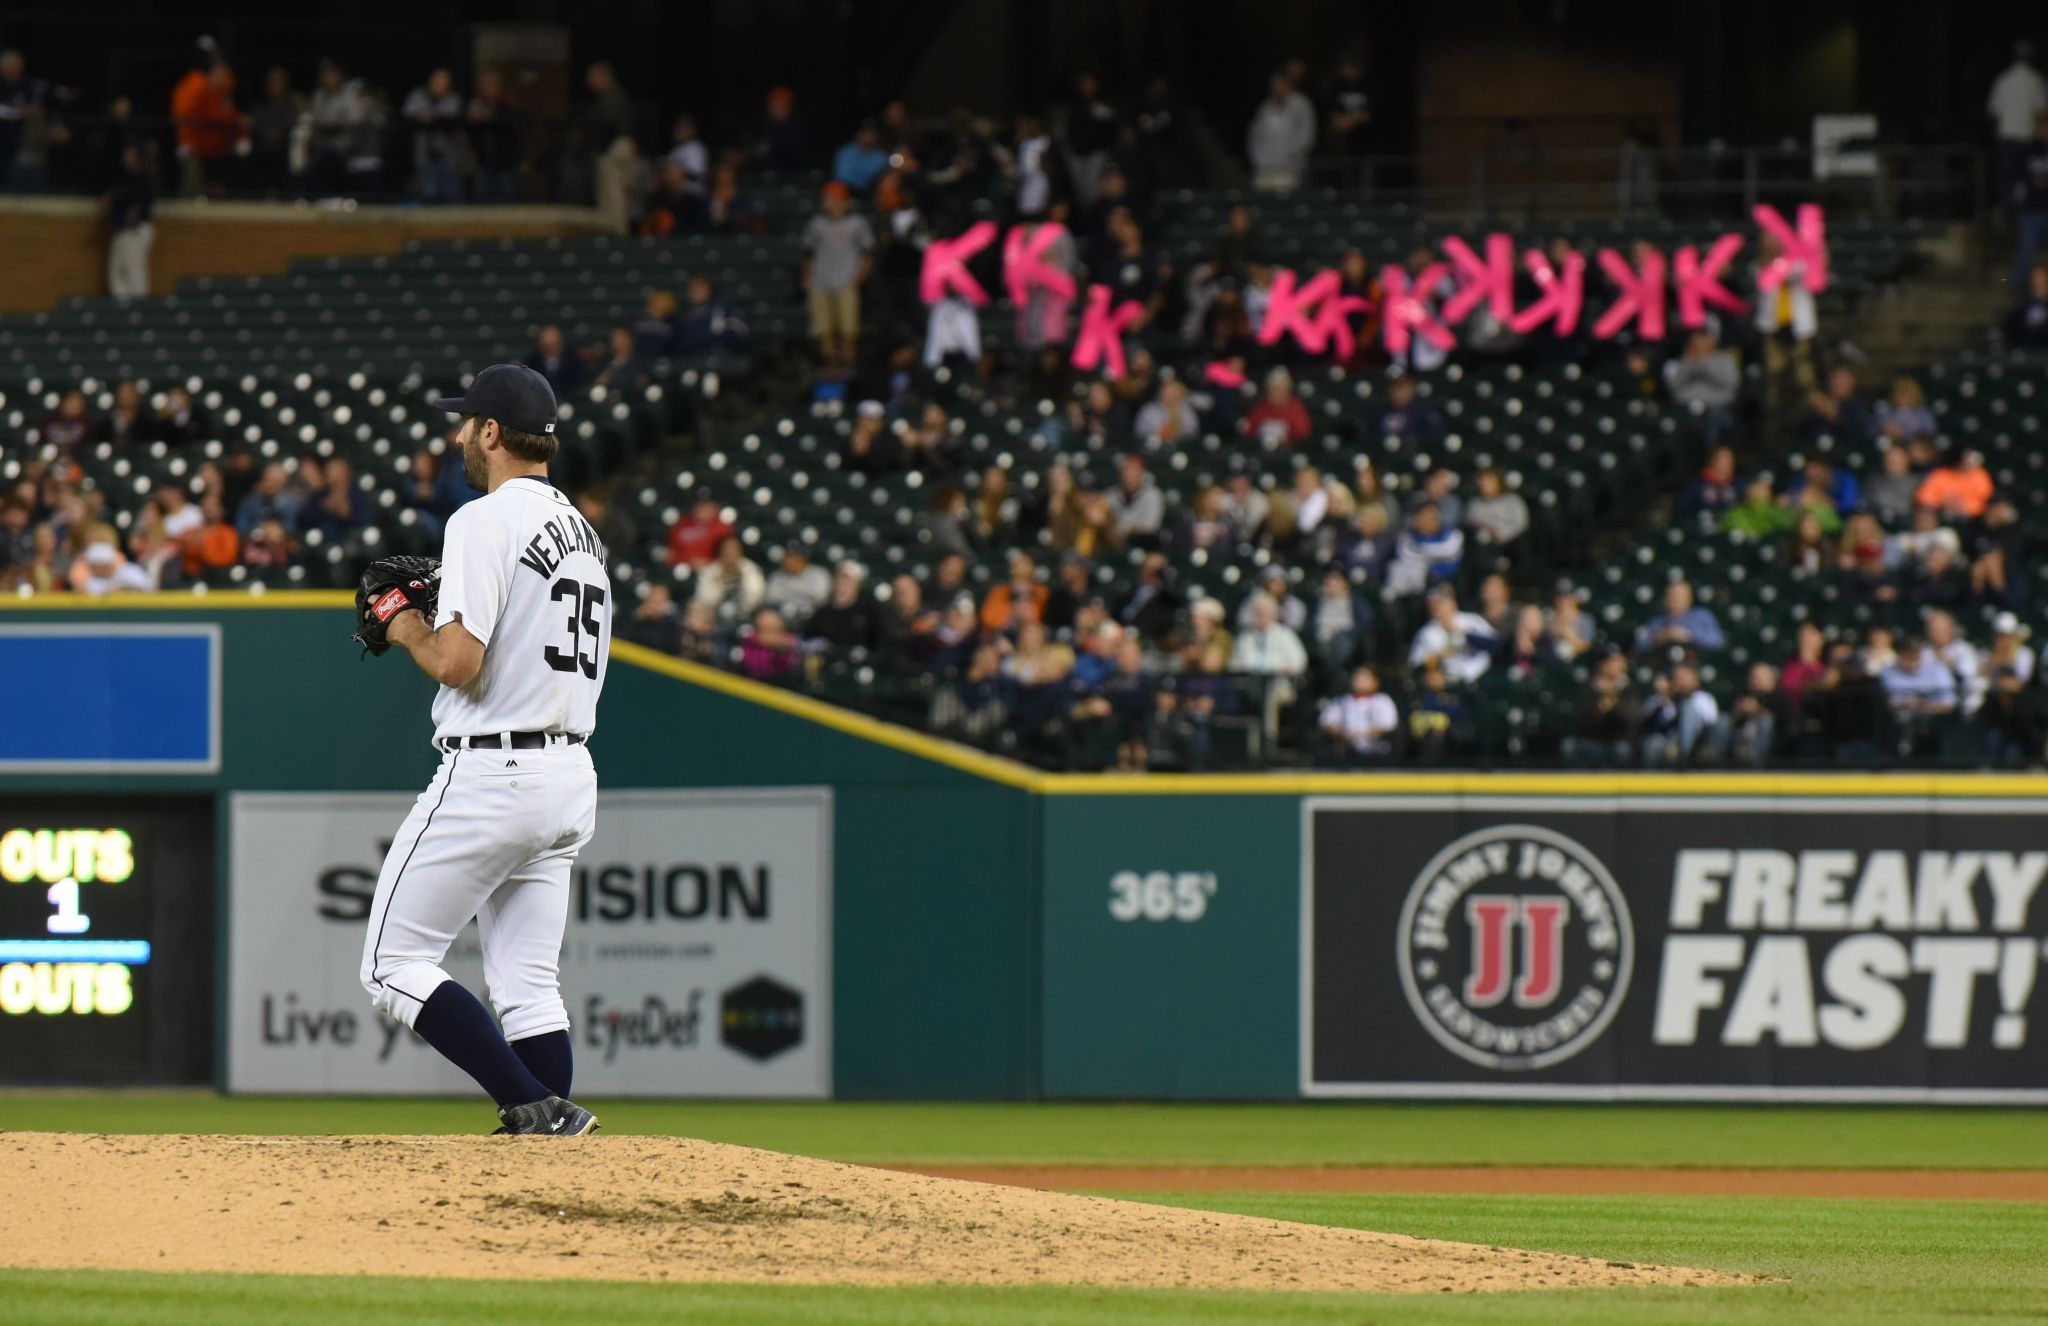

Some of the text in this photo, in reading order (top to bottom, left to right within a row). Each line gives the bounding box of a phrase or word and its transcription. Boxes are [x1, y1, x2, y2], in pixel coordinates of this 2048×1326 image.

[920, 220, 997, 306] K
[1003, 221, 1077, 309] K
[1674, 232, 1750, 328] K
[1071, 283, 1144, 380] K
[1380, 264, 1457, 353] K
[544, 577, 605, 680] 35
[0, 828, 134, 883] OUTS
[574, 864, 769, 923] ISION
[1413, 841, 1509, 950] JIMMY
[1670, 849, 2048, 931] FREAKY
[46, 877, 91, 934] 1
[0, 962, 134, 1015] OUTS
[1463, 894, 1570, 1008] JJ
[1653, 934, 2038, 1050] FAST!
[261, 995, 358, 1046] Live
